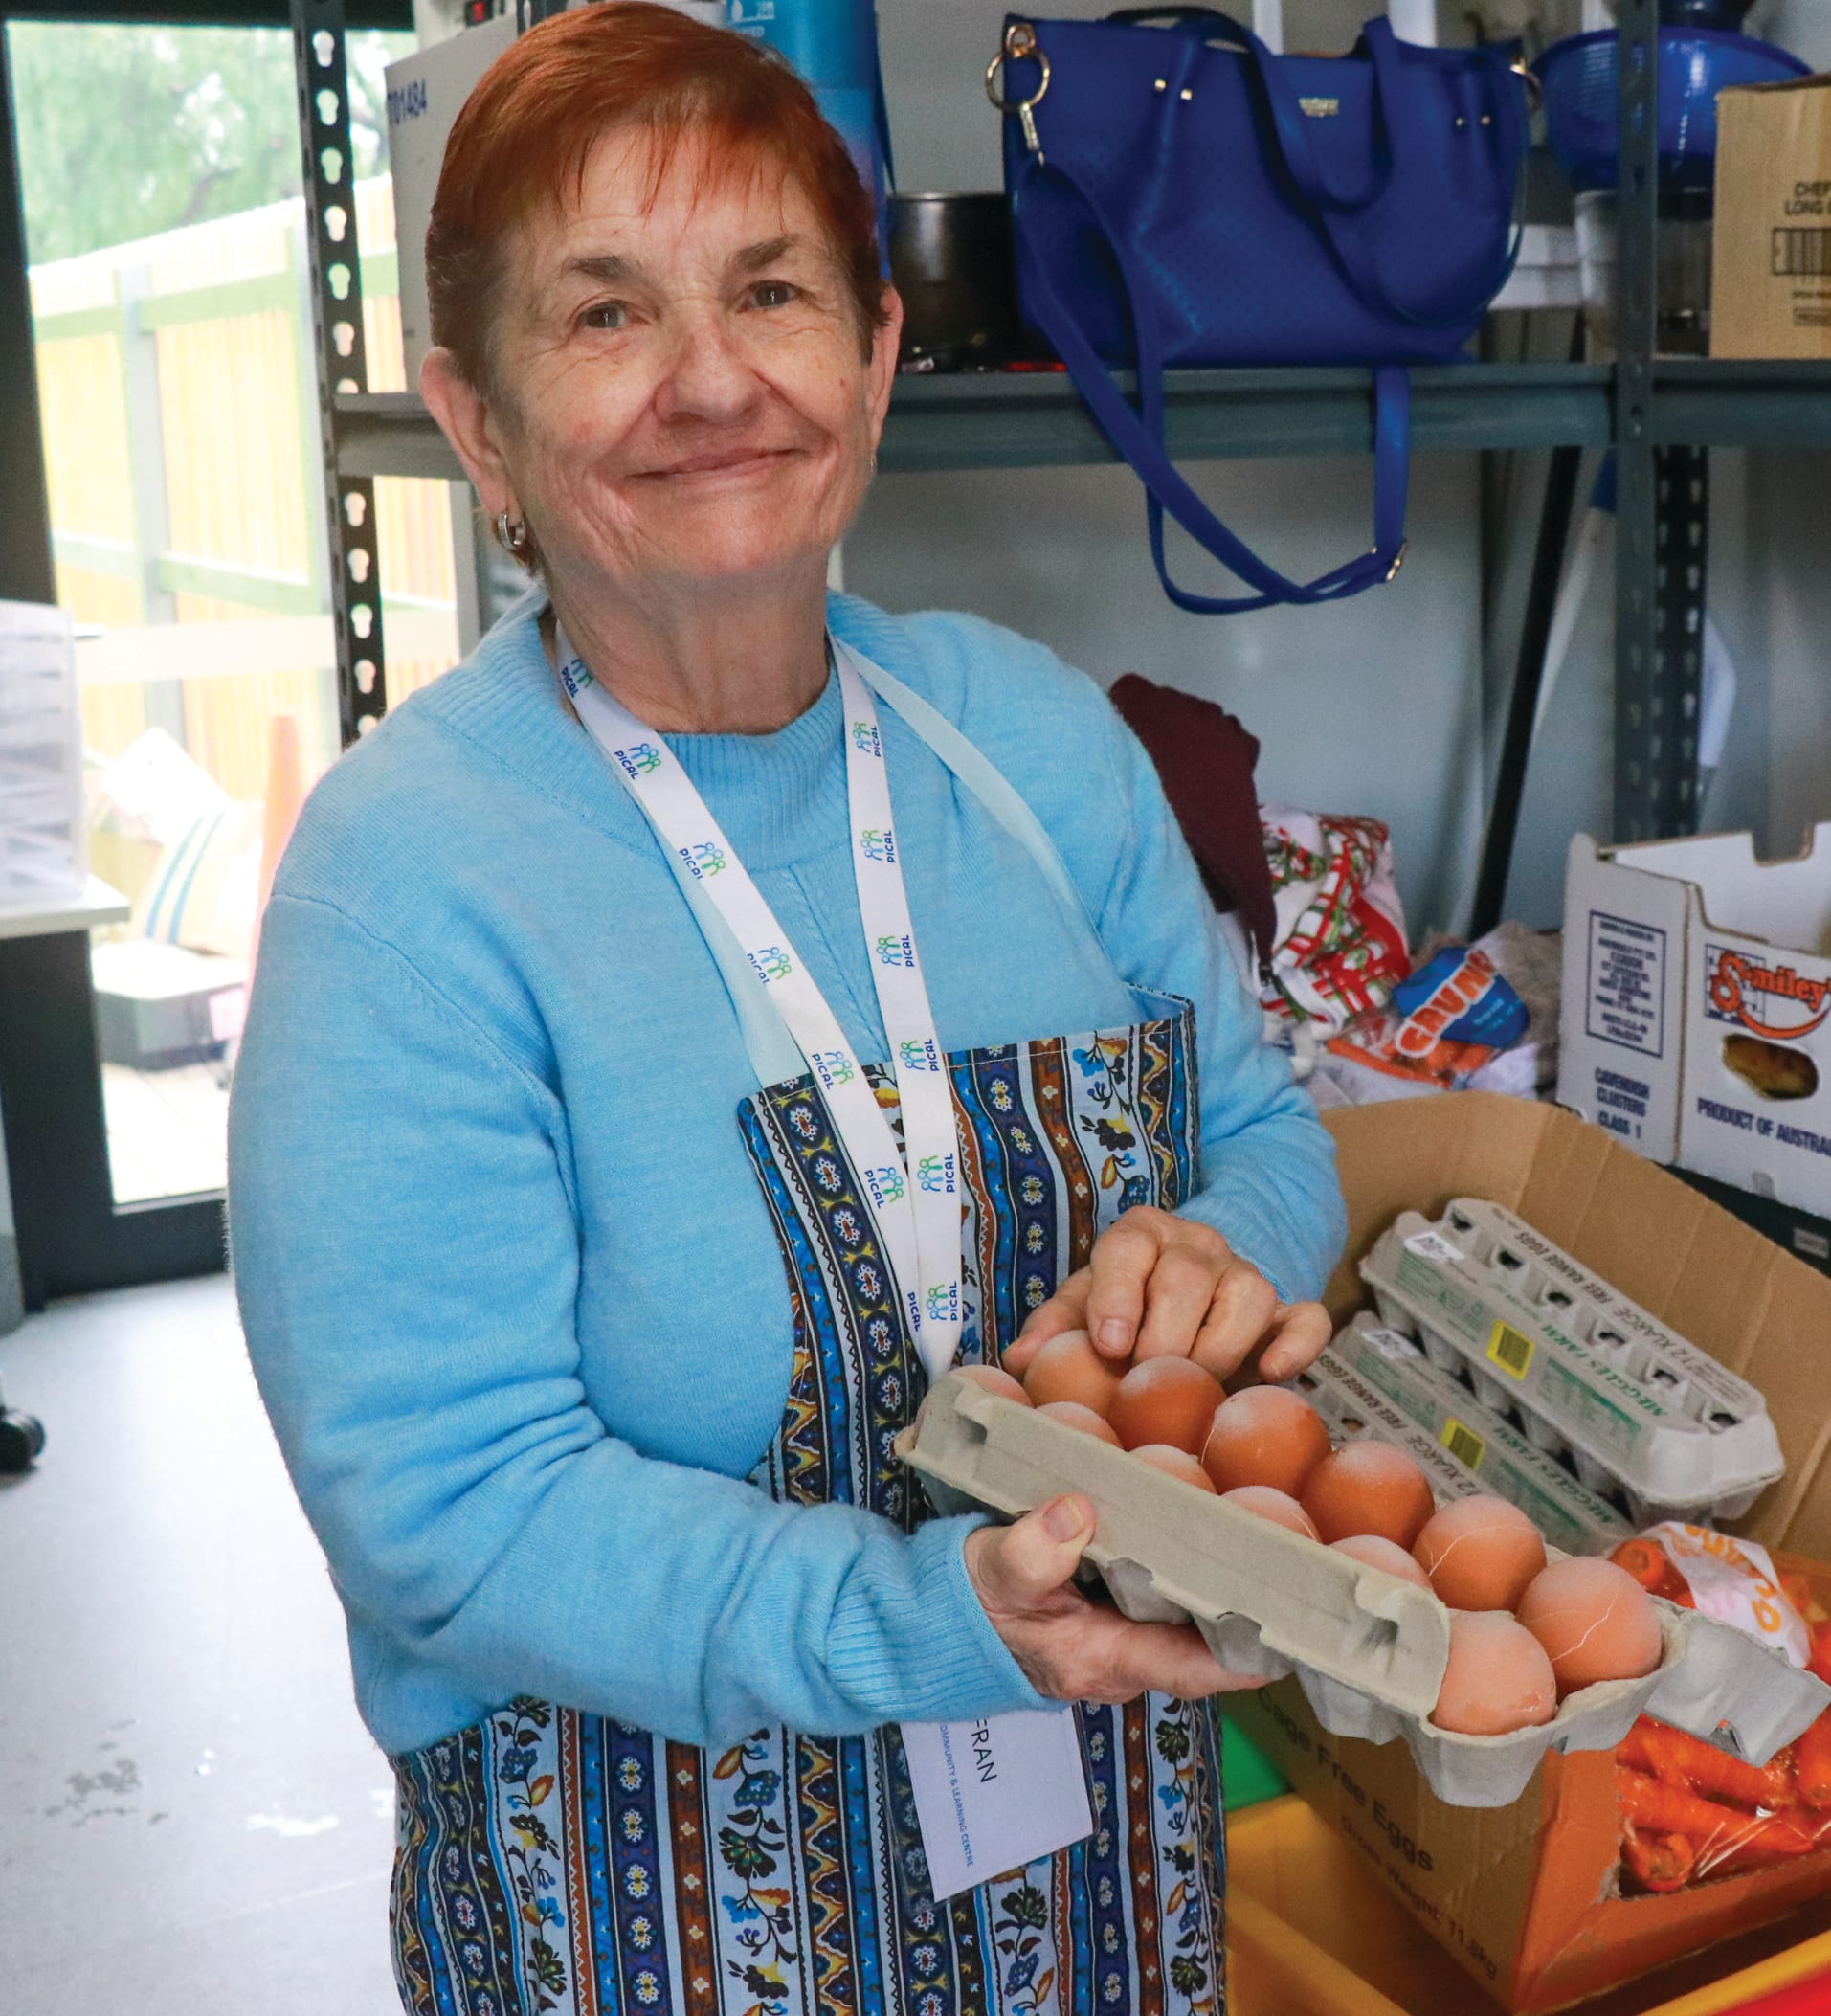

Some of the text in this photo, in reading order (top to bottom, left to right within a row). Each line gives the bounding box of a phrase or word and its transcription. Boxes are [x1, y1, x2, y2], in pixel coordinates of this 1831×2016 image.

[560, 666, 579, 699] PICAL
[871, 725, 882, 758] PICAL
[614, 750, 640, 780] PICAL
[883, 829, 896, 863] PICAL
[901, 934, 915, 968] PICAL
[811, 1053, 835, 1090] PICAL
[924, 1038, 940, 1072] PICAL
[1595, 1067, 1650, 1100] CAVENDISH
[1597, 1086, 1646, 1117] CLUSTERS
[1697, 1097, 1754, 1131] PRODUCT
[1756, 1116, 1774, 1137] OF
[1598, 1110, 1630, 1135] CLASS
[864, 1169, 885, 1209] PICAL
[944, 1153, 955, 1193] PICAL
[1515, 1231, 1551, 1256] EGGS
[1543, 1254, 1586, 1284] RANGE
[949, 1280, 958, 1322] PICAL
[1581, 1283, 1614, 1304] FREE
[907, 1291, 921, 1333] PICAL
[1614, 1308, 1676, 1349] XLARGE
[1541, 1324, 1590, 1359] FARM
[1318, 1354, 1350, 1379] EGGS
[1342, 1376, 1381, 1409] RANGE
[1590, 1359, 1666, 1417] MEGGLES
[1376, 1407, 1409, 1431] FREE
[1405, 1435, 1465, 1481] XLARGE
[940, 1723, 956, 1776] OMMUNITY
[952, 1787, 967, 1833] LEARNING
[961, 1833, 974, 1868] CENTRE
[1257, 1686, 1434, 1871] Cage Free Eggs
